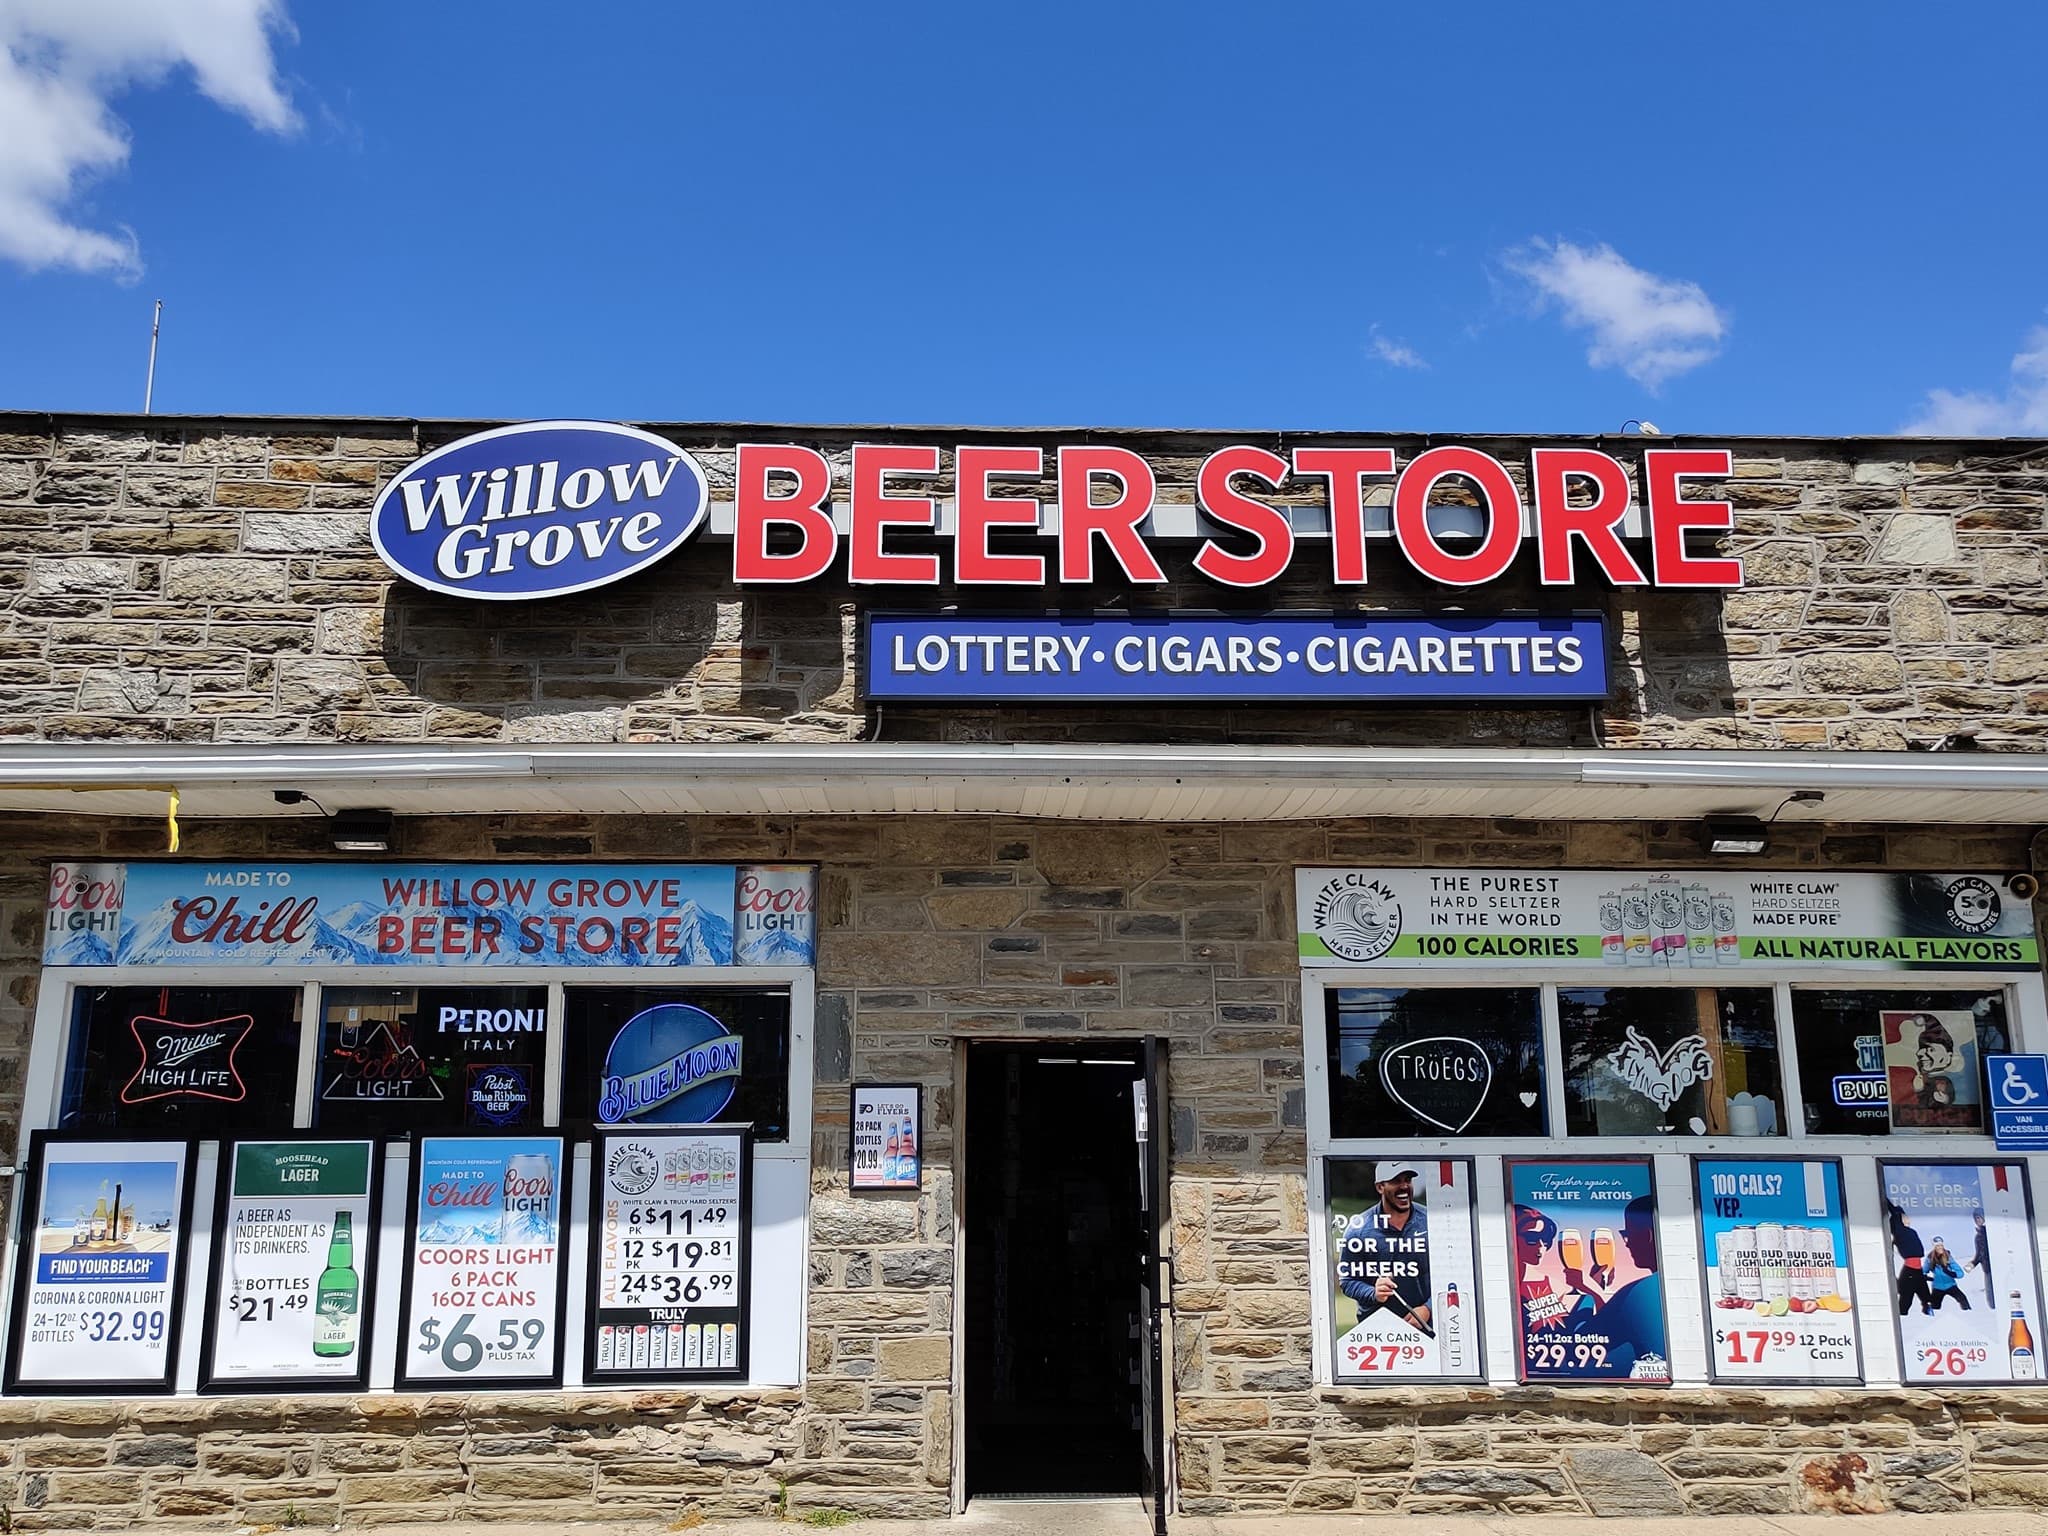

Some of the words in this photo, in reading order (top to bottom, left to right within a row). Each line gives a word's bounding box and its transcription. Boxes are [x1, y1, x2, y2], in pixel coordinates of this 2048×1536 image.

[400, 455, 683, 534] Willow
[732, 443, 1169, 585] BEER
[1193, 445, 1745, 588] STORE
[437, 511, 661, 581] Grove
[893, 634, 1088, 674] LOTTERY
[1113, 634, 1284, 674] CIGARS
[1306, 634, 1585, 674] CIGARETTES
[205, 871, 260, 887] MADE
[266, 871, 291, 887] TO
[1430, 877, 1470, 892] THE
[1481, 877, 1560, 893] PUREST
[382, 878, 537, 907] WILLOW
[547, 878, 681, 908] GROVE
[1750, 883, 1795, 895] WHITE
[1946, 880, 1966, 898] LOW
[1970, 880, 1996, 898] CARB
[1314, 878, 1342, 930] WHITE
[1345, 873, 1396, 902] CLAW
[1430, 896, 1478, 908] HARD
[1489, 896, 1561, 909] SELTZER
[1752, 898, 1788, 909] HARD
[1791, 898, 1840, 909] SELTZER
[49, 911, 117, 931] LIGHT
[171, 896, 319, 945] Chill
[746, 913, 806, 930] LIGHT
[1431, 913, 1449, 926] IN
[1456, 913, 1489, 926] THE
[1498, 913, 1561, 926] WORLD
[1753, 914, 1795, 926] MADE
[1946, 910, 1979, 933] GLUTEN
[1980, 910, 2000, 931] FREE
[377, 916, 501, 954] BEER
[519, 916, 682, 954] STORE
[1329, 938, 1361, 958] HARD
[1366, 912, 1398, 957] SELTZER
[155, 949, 214, 958] MOUNTAIN
[217, 949, 247, 958] COLD
[1416, 937, 1458, 955] 100
[1464, 937, 1580, 956] CALORIES
[1753, 940, 1794, 958] ALL
[1799, 940, 1911, 959] NATURAL
[1916, 941, 2022, 961] FLAVORS
[438, 1007, 545, 1033] PERONI
[156, 1033, 226, 1059] Miller
[463, 1039, 516, 1051] ITALY
[141, 1068, 185, 1086] HIGH
[189, 1068, 231, 1086] LIFE
[484, 1074, 516, 1090] Pabst
[599, 1068, 670, 1122] BLUE
[671, 1041, 740, 1091] MOON
[356, 1080, 413, 1097] LIGHT
[472, 1091, 493, 1102] Blue
[494, 1091, 527, 1102] Ribbon
[486, 1102, 510, 1112] BEER
[855, 1121, 864, 1131] 28
[865, 1121, 882, 1131] PACK
[855, 1135, 882, 1146] BOTTLES
[275, 1154, 329, 1166] MOOSEHEAD
[608, 1145, 627, 1177] WHITE
[627, 1143, 657, 1160] CLAW
[280, 1168, 320, 1182] LAGER
[441, 1171, 470, 1179] MADE
[471, 1171, 484, 1179] TO
[1540, 1173, 1582, 1188] Together
[1583, 1178, 1610, 1189] again
[1612, 1178, 1623, 1187] in
[1711, 1174, 1736, 1195] 100
[1738, 1174, 1783, 1195] CALS?
[1889, 1184, 1910, 1194] DO
[1916, 1184, 1930, 1194] IT
[1934, 1184, 1963, 1194] FOR
[428, 1181, 499, 1207] Chill
[1531, 1191, 1554, 1200] THE
[1557, 1191, 1581, 1200] LIFE
[1590, 1191, 1632, 1200] ARTOIS
[505, 1197, 550, 1211] LIGHT
[1714, 1198, 1743, 1218] YEP.
[1890, 1197, 1919, 1208] THE
[1924, 1197, 1980, 1208] CHEERS
[237, 1209, 244, 1222] A
[247, 1209, 274, 1222] BEER
[276, 1208, 291, 1222] AS
[629, 1207, 641, 1225] 6
[645, 1207, 727, 1235] $11.49
[1333, 1214, 1366, 1231] DO
[1374, 1214, 1391, 1229] IT
[235, 1224, 309, 1238] INDEPENDENT
[311, 1223, 326, 1238] AS
[605, 1200, 619, 1269] FLAVORS
[629, 1226, 642, 1235] PK
[234, 1241, 251, 1255] ITS
[253, 1240, 311, 1254] DRINKERS.
[1336, 1238, 1378, 1253] FOR
[1386, 1237, 1427, 1253] THE
[419, 1249, 489, 1265] COORS
[495, 1248, 555, 1265] LIGHT
[623, 1240, 644, 1258] 12
[652, 1239, 731, 1268] $19.81
[1736, 1250, 1758, 1259] BUD
[1761, 1250, 1783, 1259] BUD
[1787, 1251, 1808, 1259] BUD
[1811, 1252, 1832, 1260] BUD
[50, 1259, 78, 1275] FIND
[79, 1259, 110, 1275] YOUR
[626, 1260, 640, 1269] PK
[1336, 1261, 1419, 1278] CHEERS
[246, 1278, 309, 1290] BOTTLES
[451, 1271, 460, 1287] 6
[467, 1271, 518, 1287] PACK
[604, 1275, 616, 1303] ALL
[620, 1274, 648, 1292] 24
[651, 1274, 733, 1303] $36.99
[33, 1291, 76, 1305] CORONA
[78, 1291, 86, 1304] &
[87, 1291, 132, 1304] CORONA
[133, 1290, 165, 1304] LIGHT
[431, 1291, 477, 1307] 16OZ
[481, 1291, 536, 1307] CANS
[627, 1295, 641, 1304] PK
[1528, 1293, 1559, 1311] SUPER
[229, 1294, 308, 1321] $21.49
[649, 1308, 688, 1321] TRULY
[1529, 1302, 1567, 1322] SPECIAL
[79, 1310, 165, 1342] $32.99
[32, 1330, 74, 1342] BOTTLES
[323, 1332, 346, 1340] LAGER
[418, 1313, 545, 1372] $6.59
[1350, 1333, 1363, 1342] 30
[1366, 1333, 1383, 1342] PK
[1386, 1333, 1420, 1342] CANS
[1449, 1314, 1461, 1367] ULTRA
[1574, 1333, 1609, 1343] Bottles
[1800, 1335, 1815, 1346] 12
[1818, 1335, 1852, 1346] Pack
[488, 1352, 513, 1360] PLUS
[516, 1352, 536, 1360] TAX
[1527, 1344, 1607, 1368] $29.99
[1810, 1348, 1844, 1360] Cans
